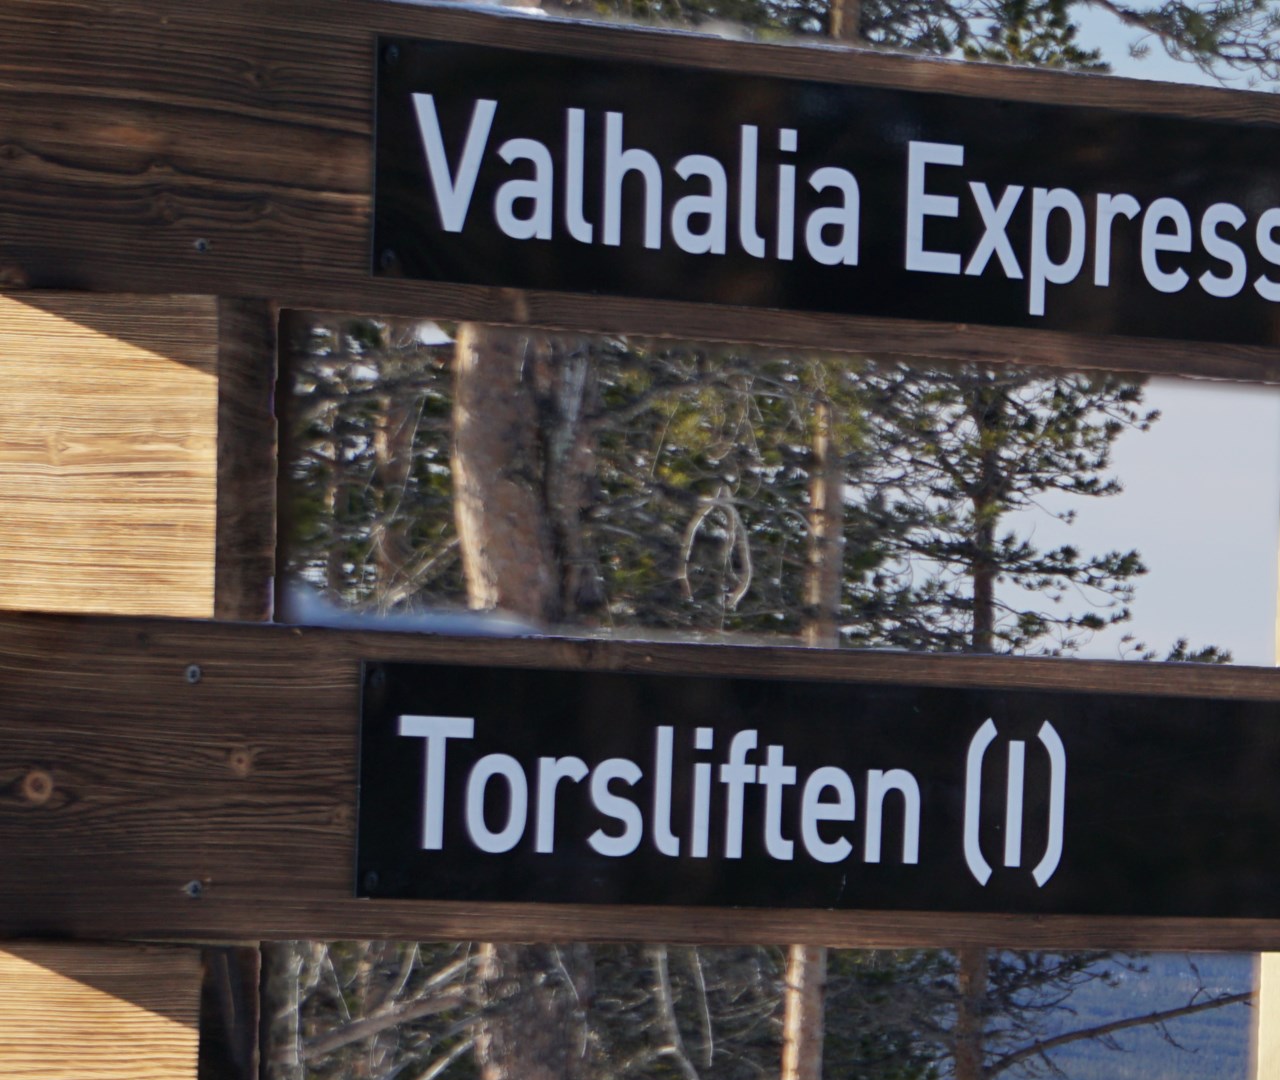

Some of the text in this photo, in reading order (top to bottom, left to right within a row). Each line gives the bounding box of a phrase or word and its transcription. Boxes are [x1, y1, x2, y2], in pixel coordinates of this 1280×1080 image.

[410, 91, 861, 267] Valhalia
[398, 714, 1067, 889] Torsliften (I)
